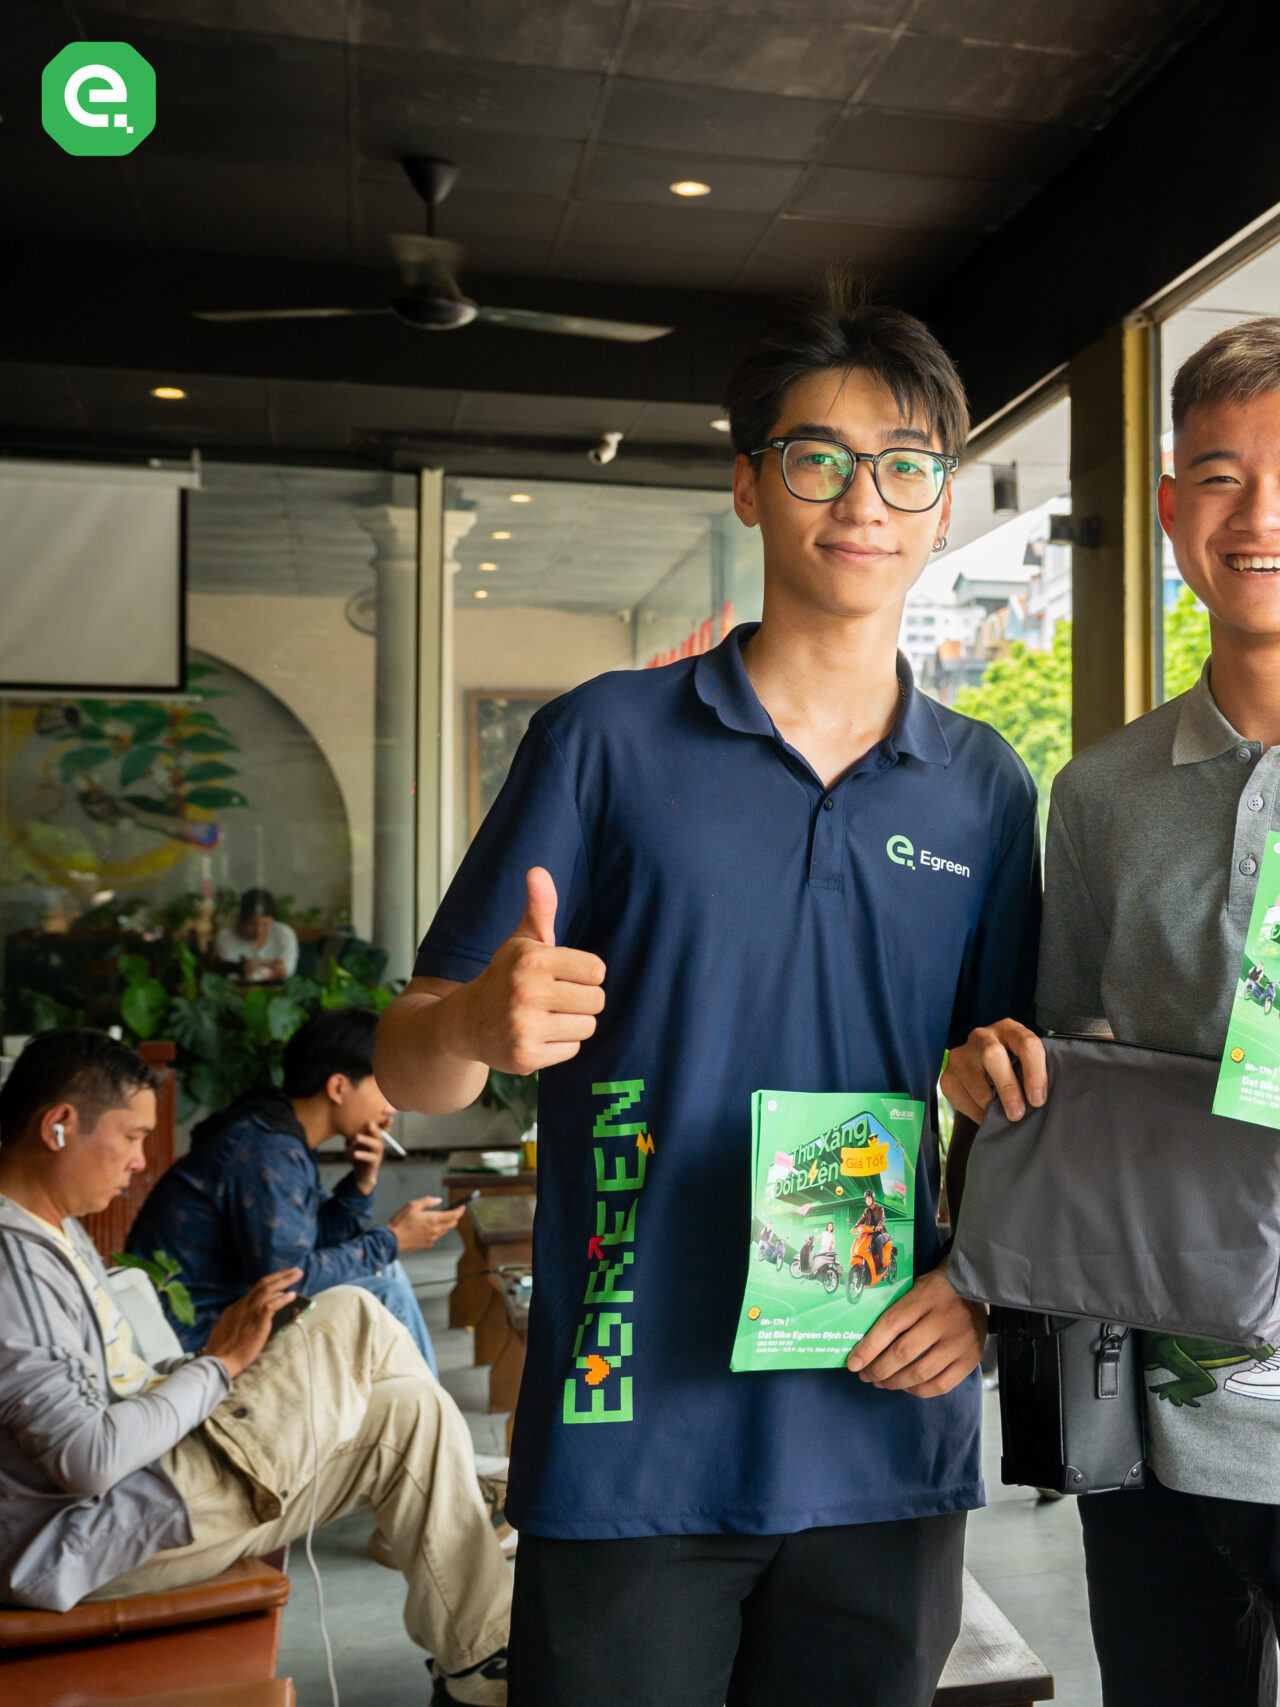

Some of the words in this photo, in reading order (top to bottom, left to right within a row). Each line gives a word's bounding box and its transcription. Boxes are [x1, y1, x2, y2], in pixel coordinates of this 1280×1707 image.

[920, 850, 970, 878] Egreen
[792, 1143, 816, 1167] Thu
[818, 1117, 868, 1156] Xăng
[845, 1157, 863, 1169] Giá
[866, 1153, 884, 1166] Tốt
[563, 1079, 648, 1424] EGREEN
[773, 1331, 791, 1339] Bike
[792, 1331, 821, 1341] Egreen
